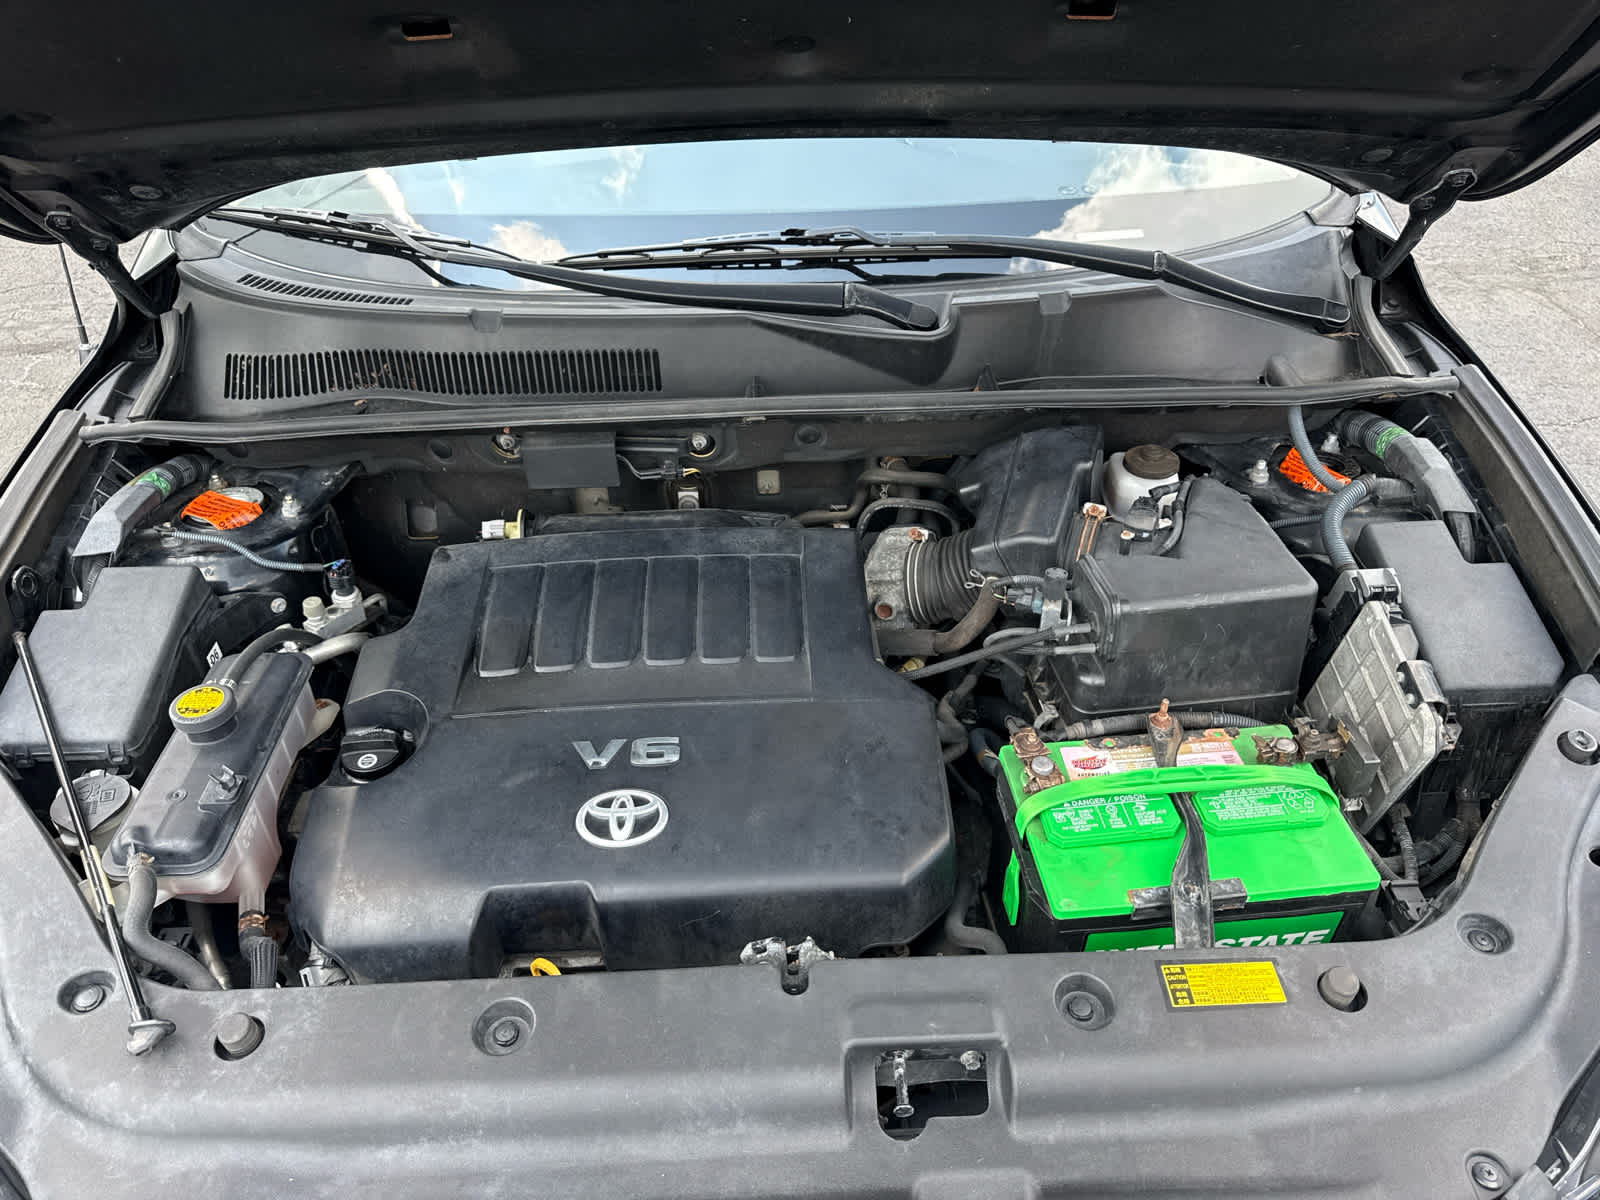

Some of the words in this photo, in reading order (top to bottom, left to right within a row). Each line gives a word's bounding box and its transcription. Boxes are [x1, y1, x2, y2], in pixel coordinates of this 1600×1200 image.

[571, 737, 680, 769] V6
[1072, 797, 1105, 807] DANGER
[1114, 794, 1146, 802] POISON
